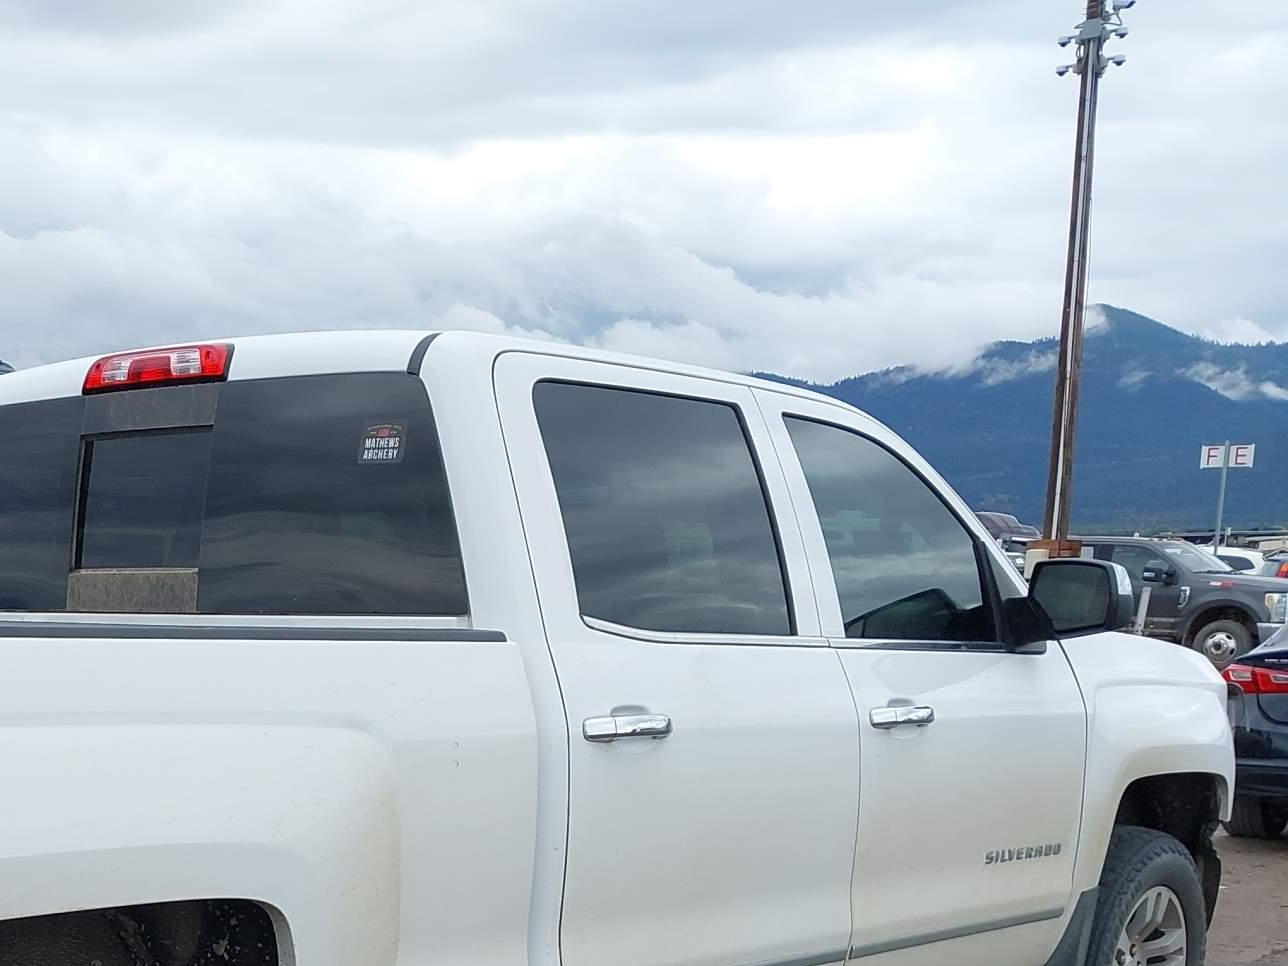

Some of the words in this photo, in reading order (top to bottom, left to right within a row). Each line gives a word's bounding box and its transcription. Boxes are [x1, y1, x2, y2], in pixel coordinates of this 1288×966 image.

[365, 437, 399, 448] MATHEWS
[362, 448, 399, 460] ARCHERY
[1206, 447, 1220, 465] F
[1235, 446, 1249, 465] E
[984, 842, 1062, 865] SILVERADO
